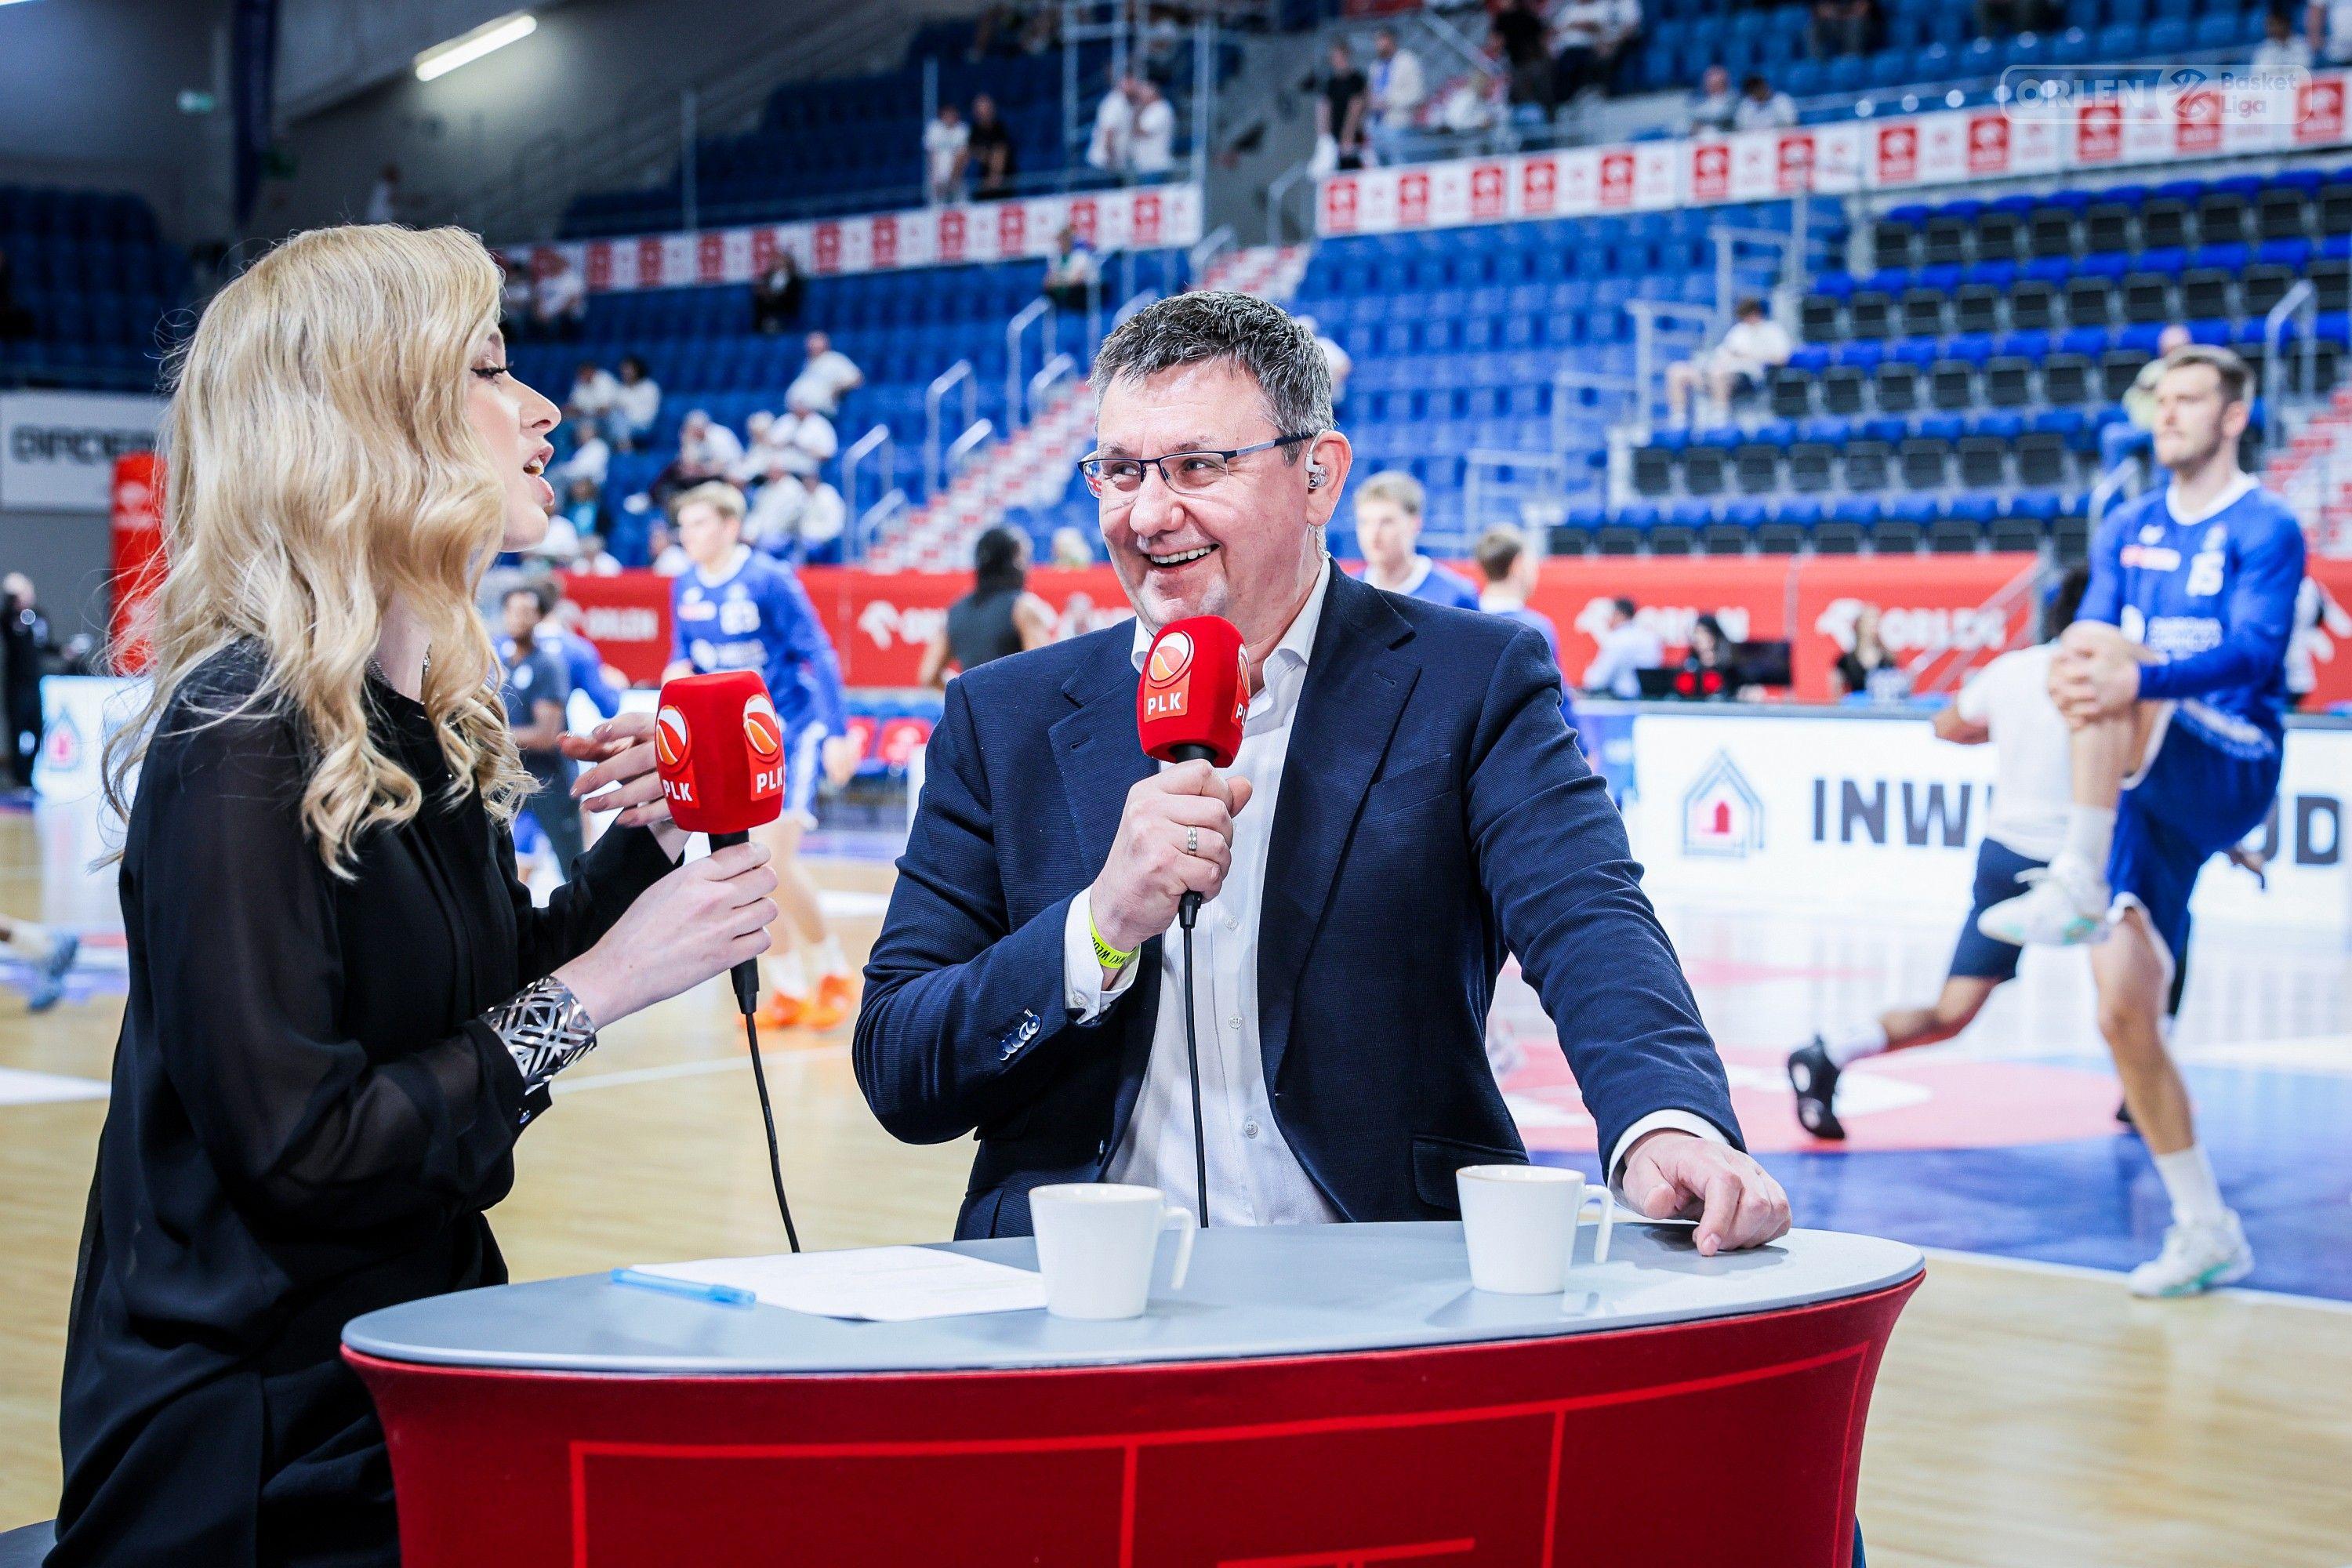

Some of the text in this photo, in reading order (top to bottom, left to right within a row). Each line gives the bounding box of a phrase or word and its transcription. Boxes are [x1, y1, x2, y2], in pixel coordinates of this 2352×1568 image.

[1147, 691, 1181, 716] PLK
[1235, 702, 1247, 727] PL
[662, 779, 693, 802] PLK
[756, 766, 783, 793] PLK
